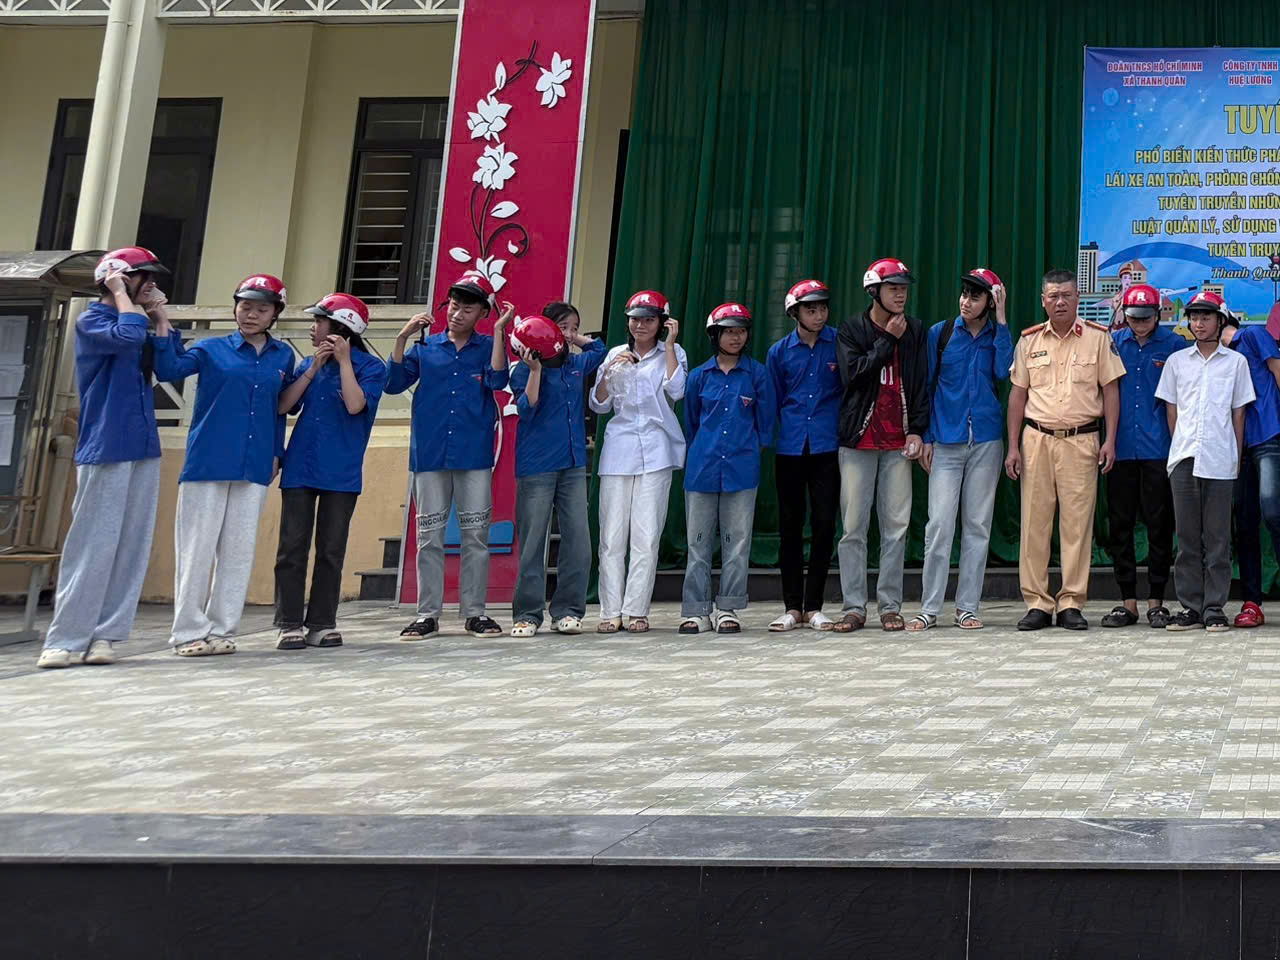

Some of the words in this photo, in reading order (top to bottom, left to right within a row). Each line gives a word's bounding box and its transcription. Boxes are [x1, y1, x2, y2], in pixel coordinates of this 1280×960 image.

[1131, 62, 1152, 72] TNCS
[1181, 61, 1203, 71] MINH
[1223, 59, 1245, 71] CÔNG
[1246, 61, 1256, 71] TY
[1256, 60, 1278, 71] TNHH
[1136, 76, 1162, 86] THANH
[1163, 144, 1192, 163] BIẾN
[1194, 144, 1223, 163] KIẾN
[1225, 145, 1257, 163] THỨC
[1105, 171, 1125, 187] LÁI
[1127, 173, 1144, 187] XE
[1147, 173, 1164, 187] AN
[1167, 170, 1203, 188] TOÀN,
[1205, 169, 1248, 187] PHÒNG
[1158, 193, 1197, 210] TUYÊN
[1132, 217, 1162, 237] LUẬT
[1165, 215, 1199, 235] QUẢN
[1242, 219, 1277, 236] DỤNG
[1207, 240, 1247, 257] TUYÊN
[1211, 266, 1250, 279] Thanh
